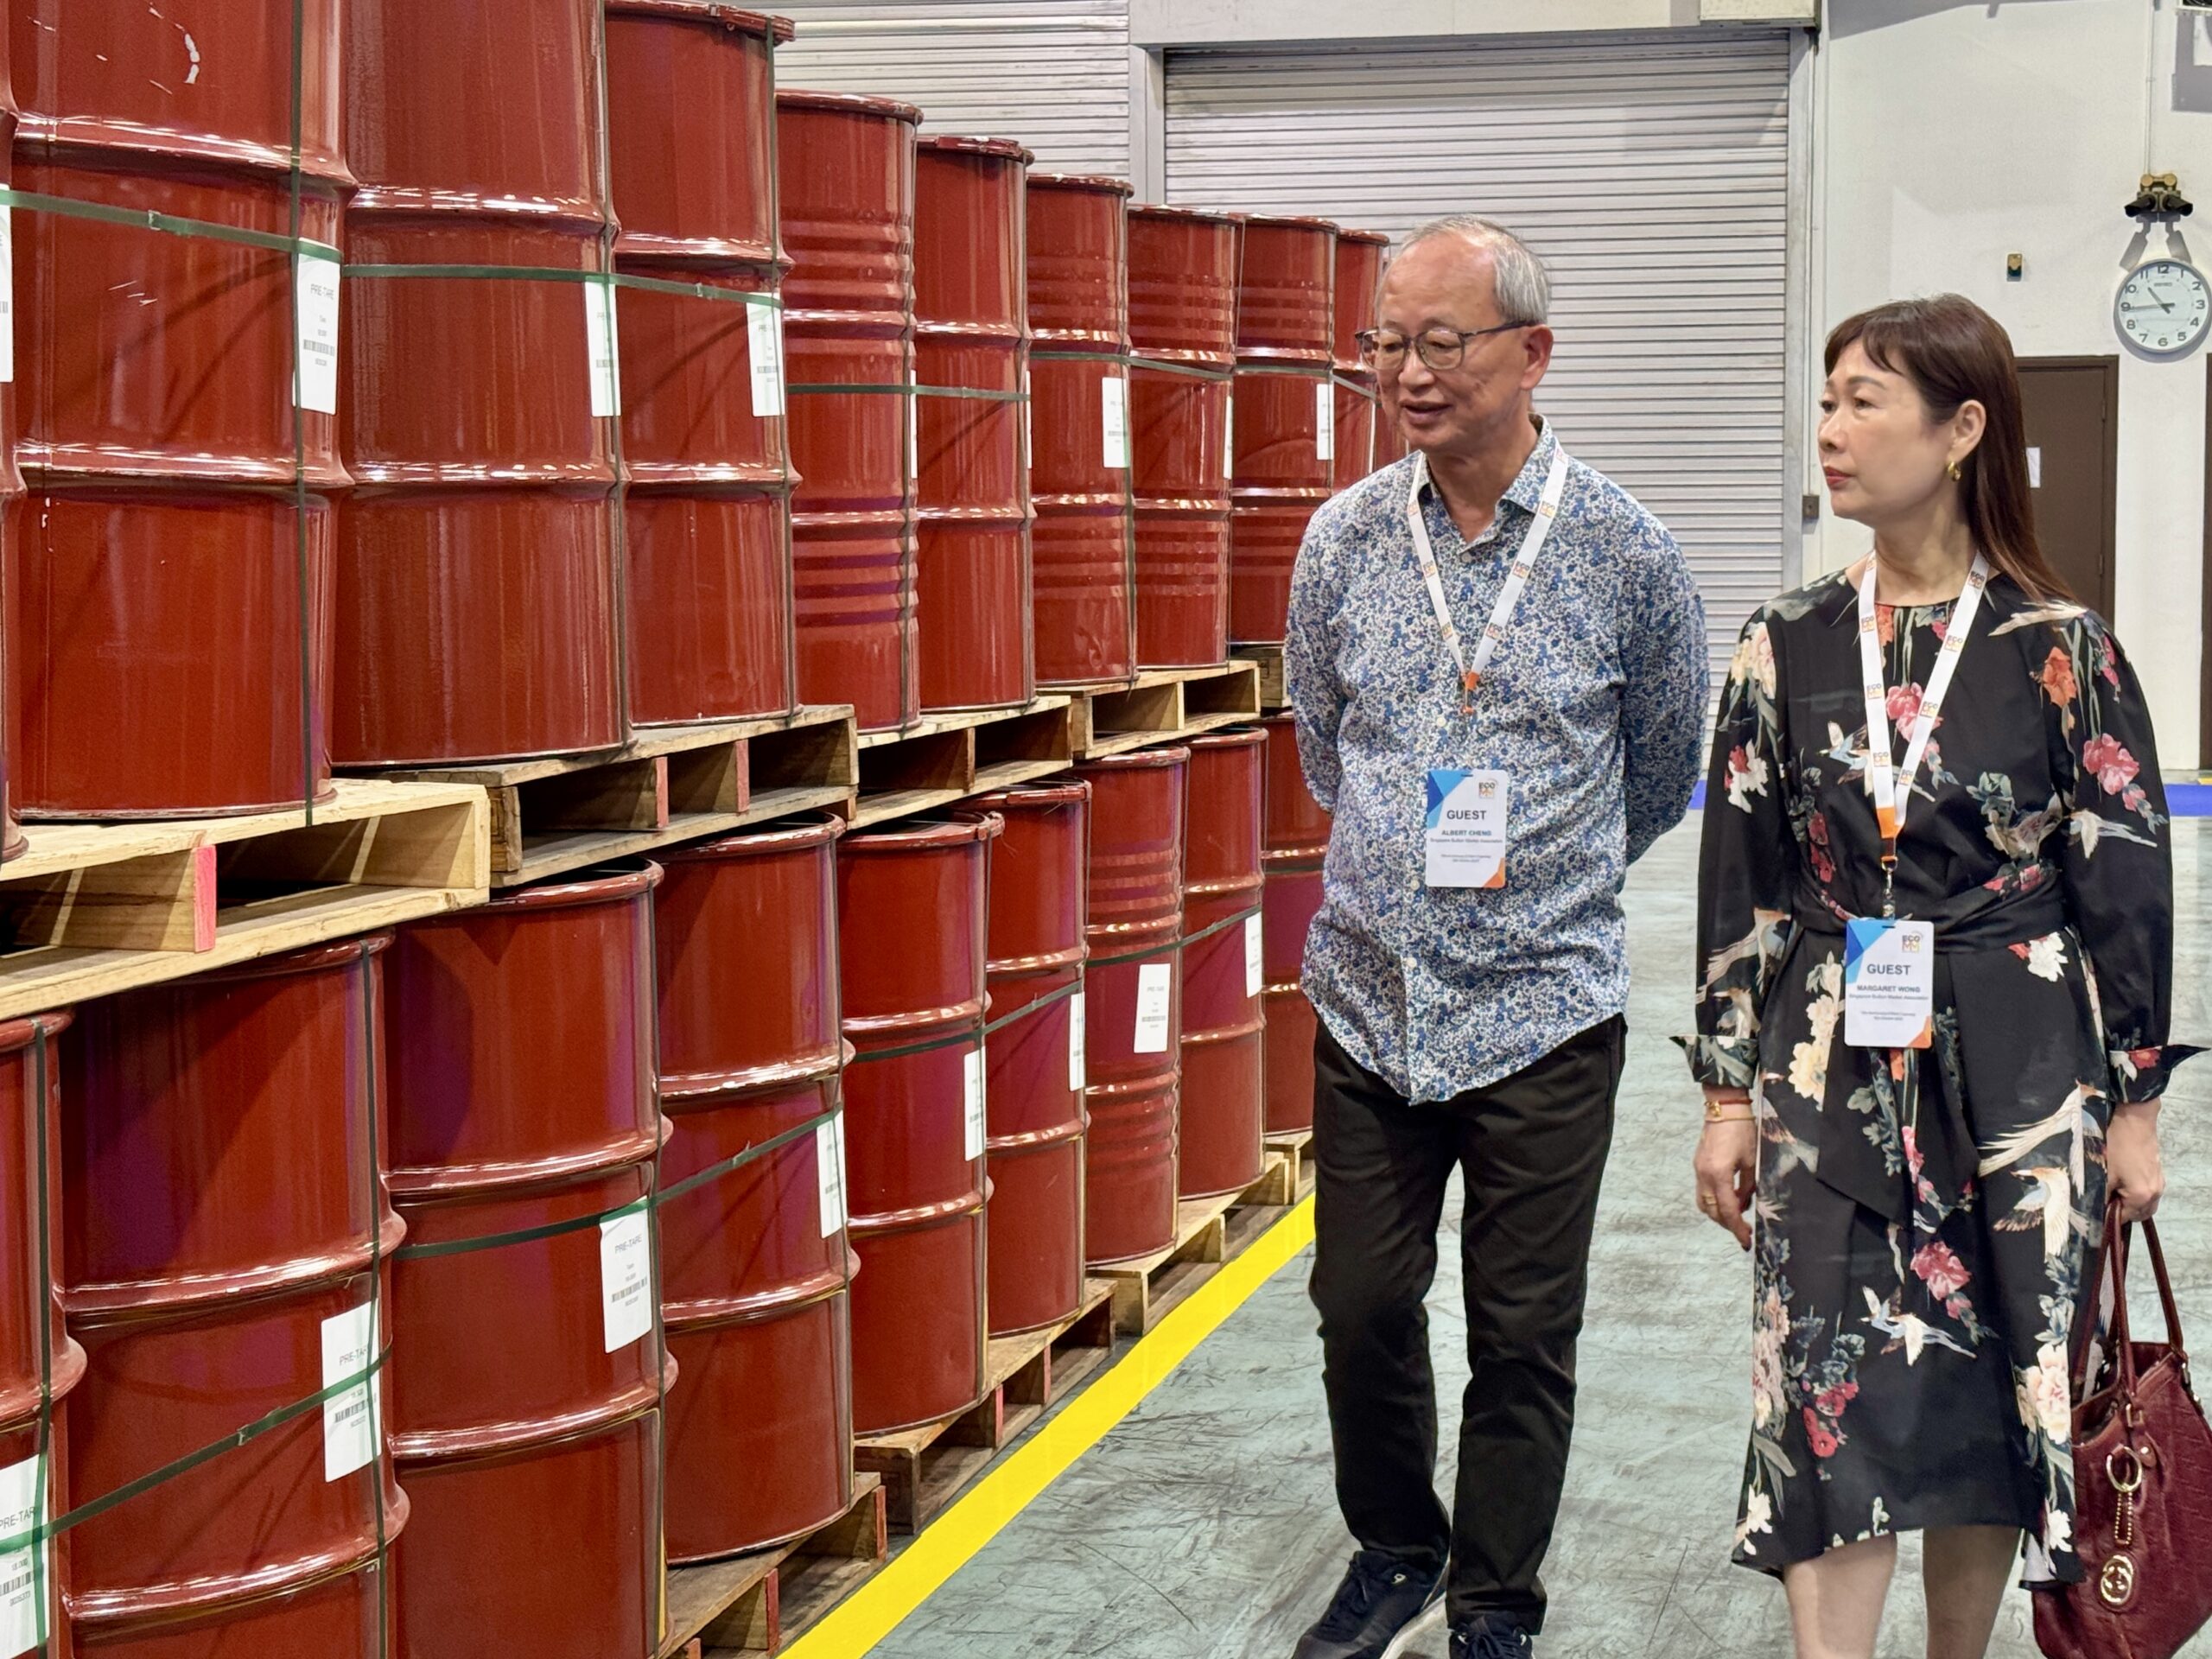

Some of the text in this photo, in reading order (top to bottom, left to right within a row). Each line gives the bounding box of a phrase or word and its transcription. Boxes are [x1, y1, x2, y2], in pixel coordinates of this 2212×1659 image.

[2140, 269, 2148, 279] 11
[2158, 264, 2169, 274] 12
[2125, 284, 2137, 294] 10
[2192, 282, 2202, 290] 2
[2120, 302, 2131, 312] 9
[2196, 300, 2205, 309] 3
[2126, 319, 2136, 329] 8
[2190, 317, 2199, 327] 4
[2139, 334, 2148, 343] 7
[2158, 337, 2169, 346] 6
[2177, 332, 2187, 341] 5
[1446, 810, 1486, 820] GUEST
[1867, 963, 1910, 975] GUEST
[0, 1506, 38, 1529] PRE-TAR
